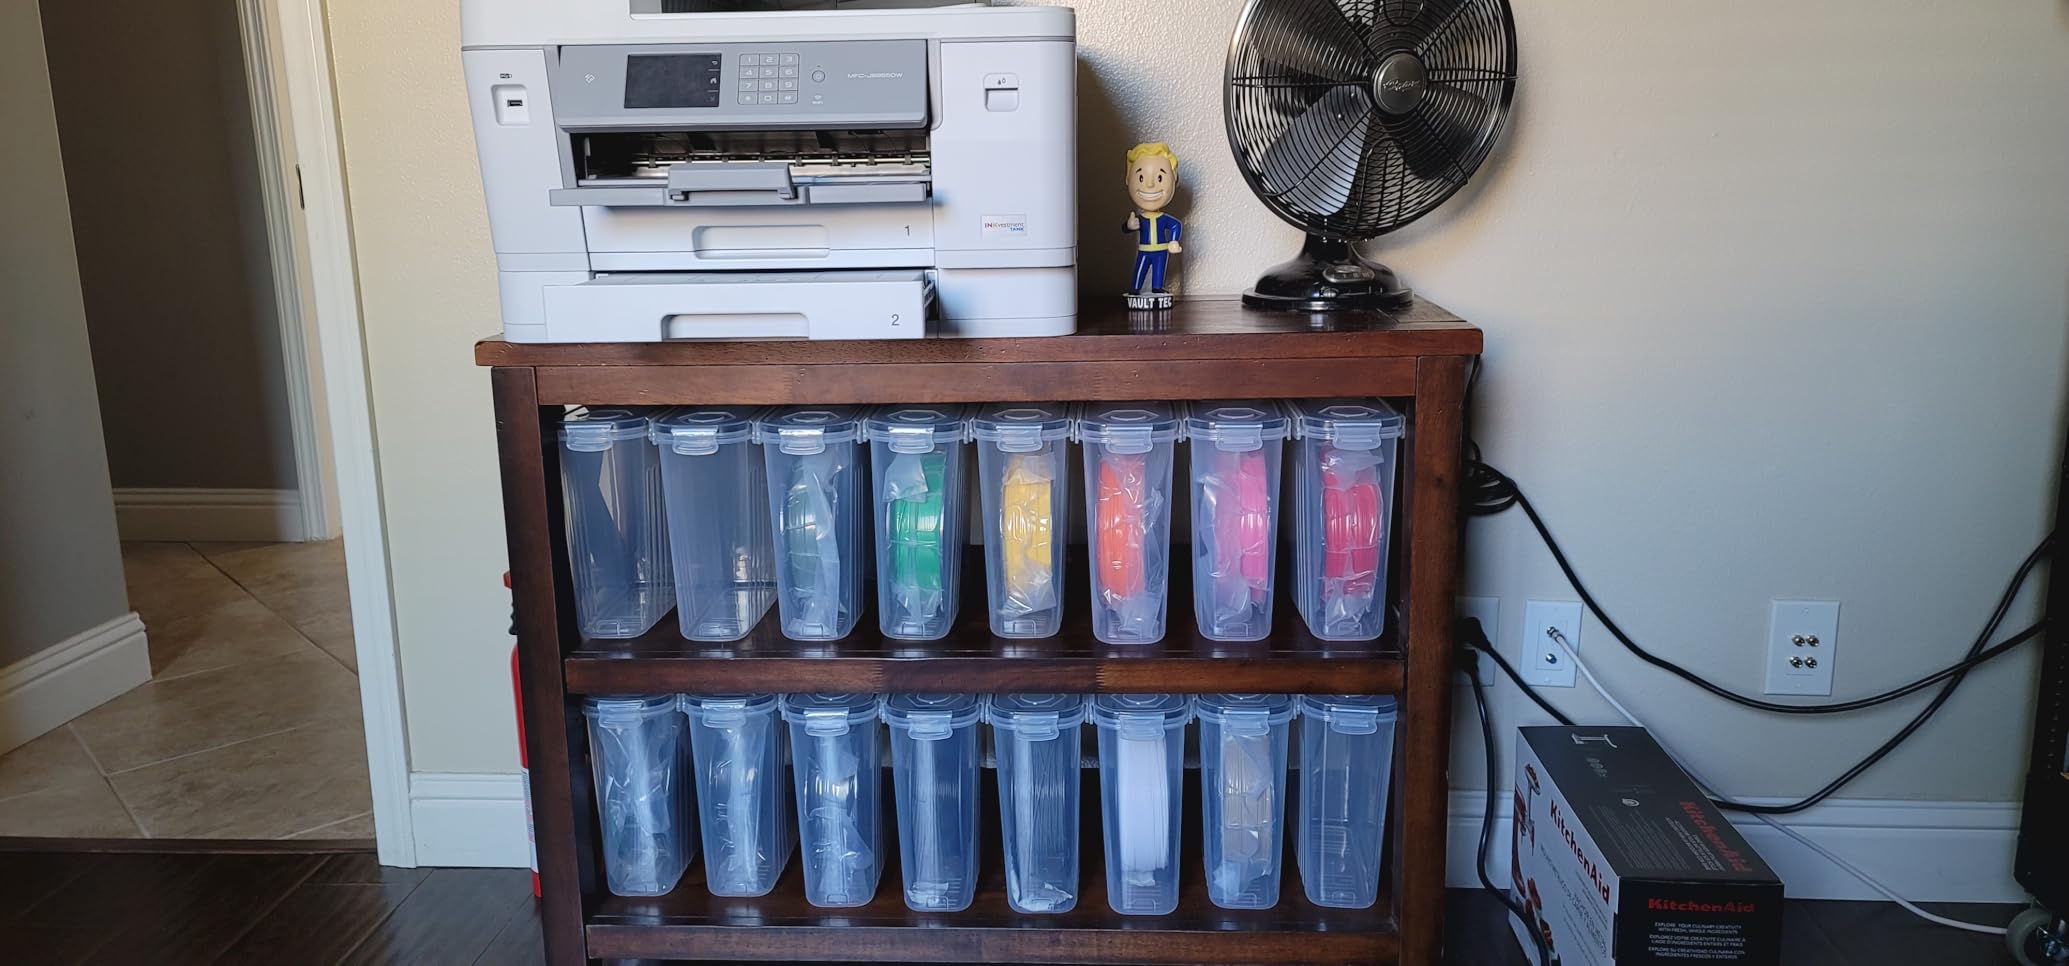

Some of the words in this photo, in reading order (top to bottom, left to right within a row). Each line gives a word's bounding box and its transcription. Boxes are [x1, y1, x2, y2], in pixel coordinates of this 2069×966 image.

[904, 224, 911, 237] 1
[1127, 297, 1155, 309] VAULT
[891, 313, 900, 326] 2
[1679, 801, 1752, 872] KitchenAid
[1550, 799, 1610, 905] KitchenAid
[1647, 898, 1755, 912] KitchenAid
